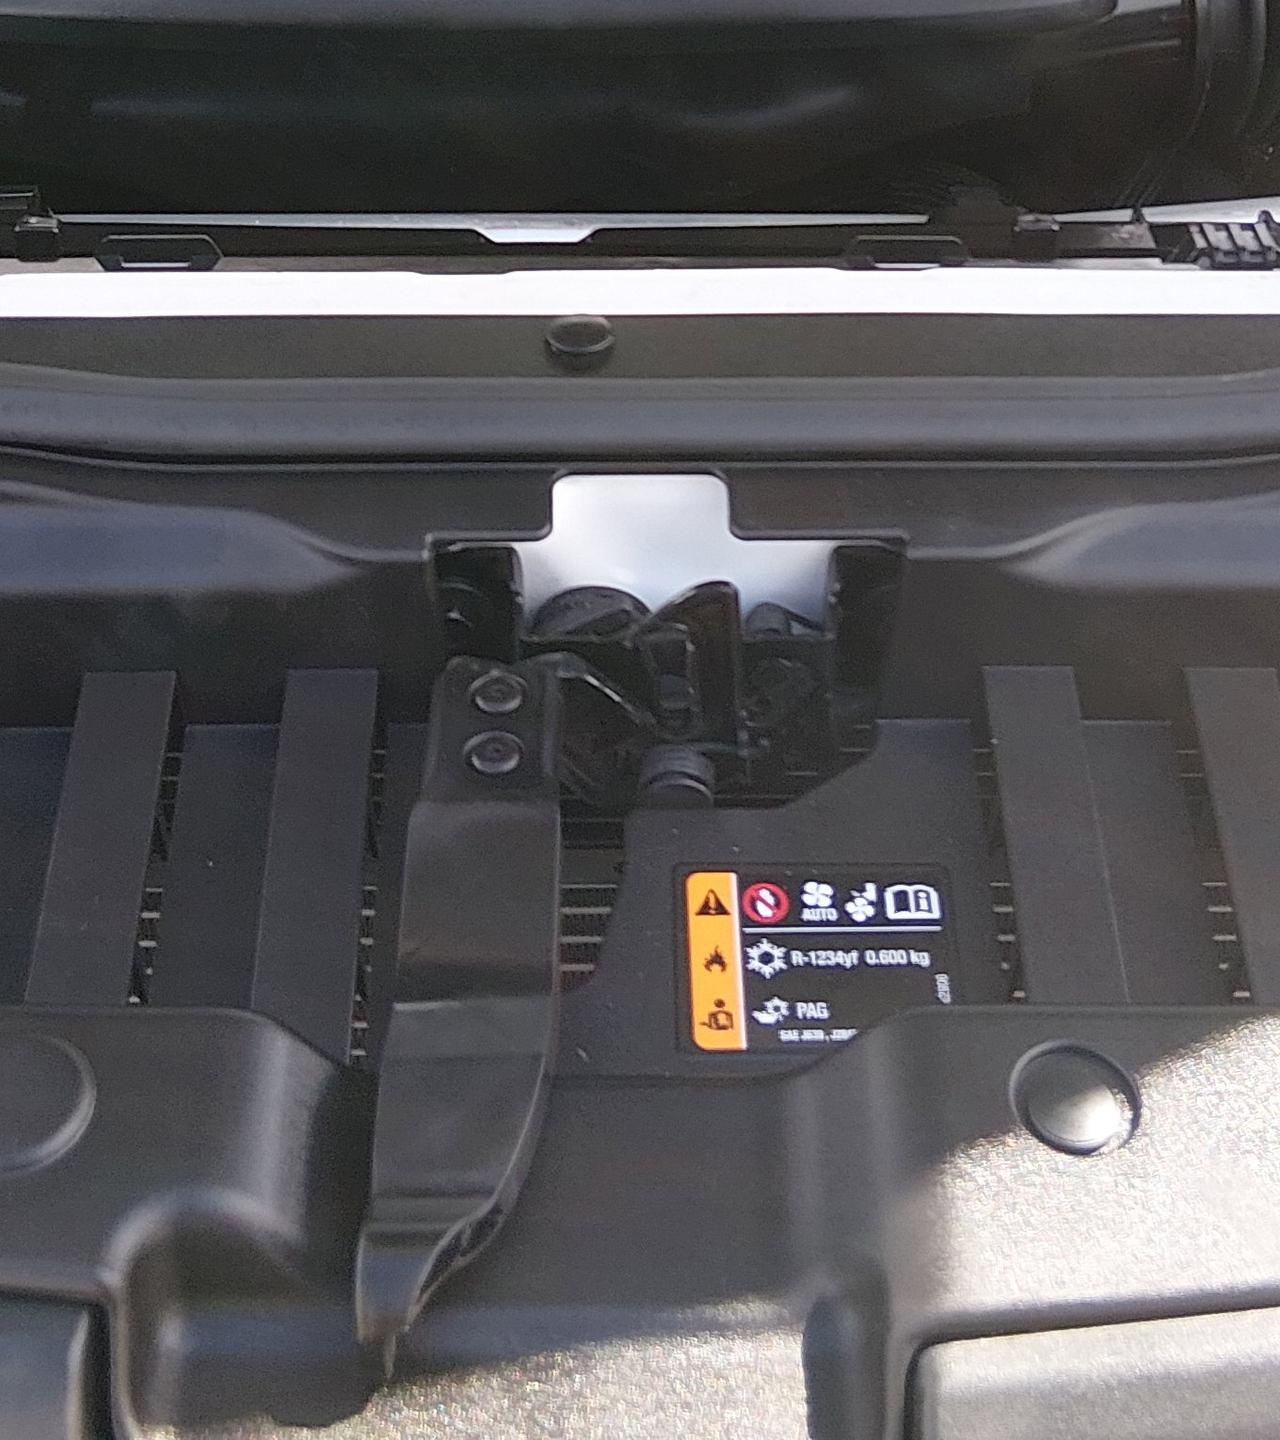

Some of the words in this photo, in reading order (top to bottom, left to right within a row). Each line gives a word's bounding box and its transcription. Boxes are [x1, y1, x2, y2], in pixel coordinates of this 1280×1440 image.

[801, 908, 838, 921] AUTO
[790, 950, 859, 968] R-1234yf
[864, 950, 908, 965] 0.600
[909, 950, 931, 968] kg
[796, 1002, 830, 1019] PAG
